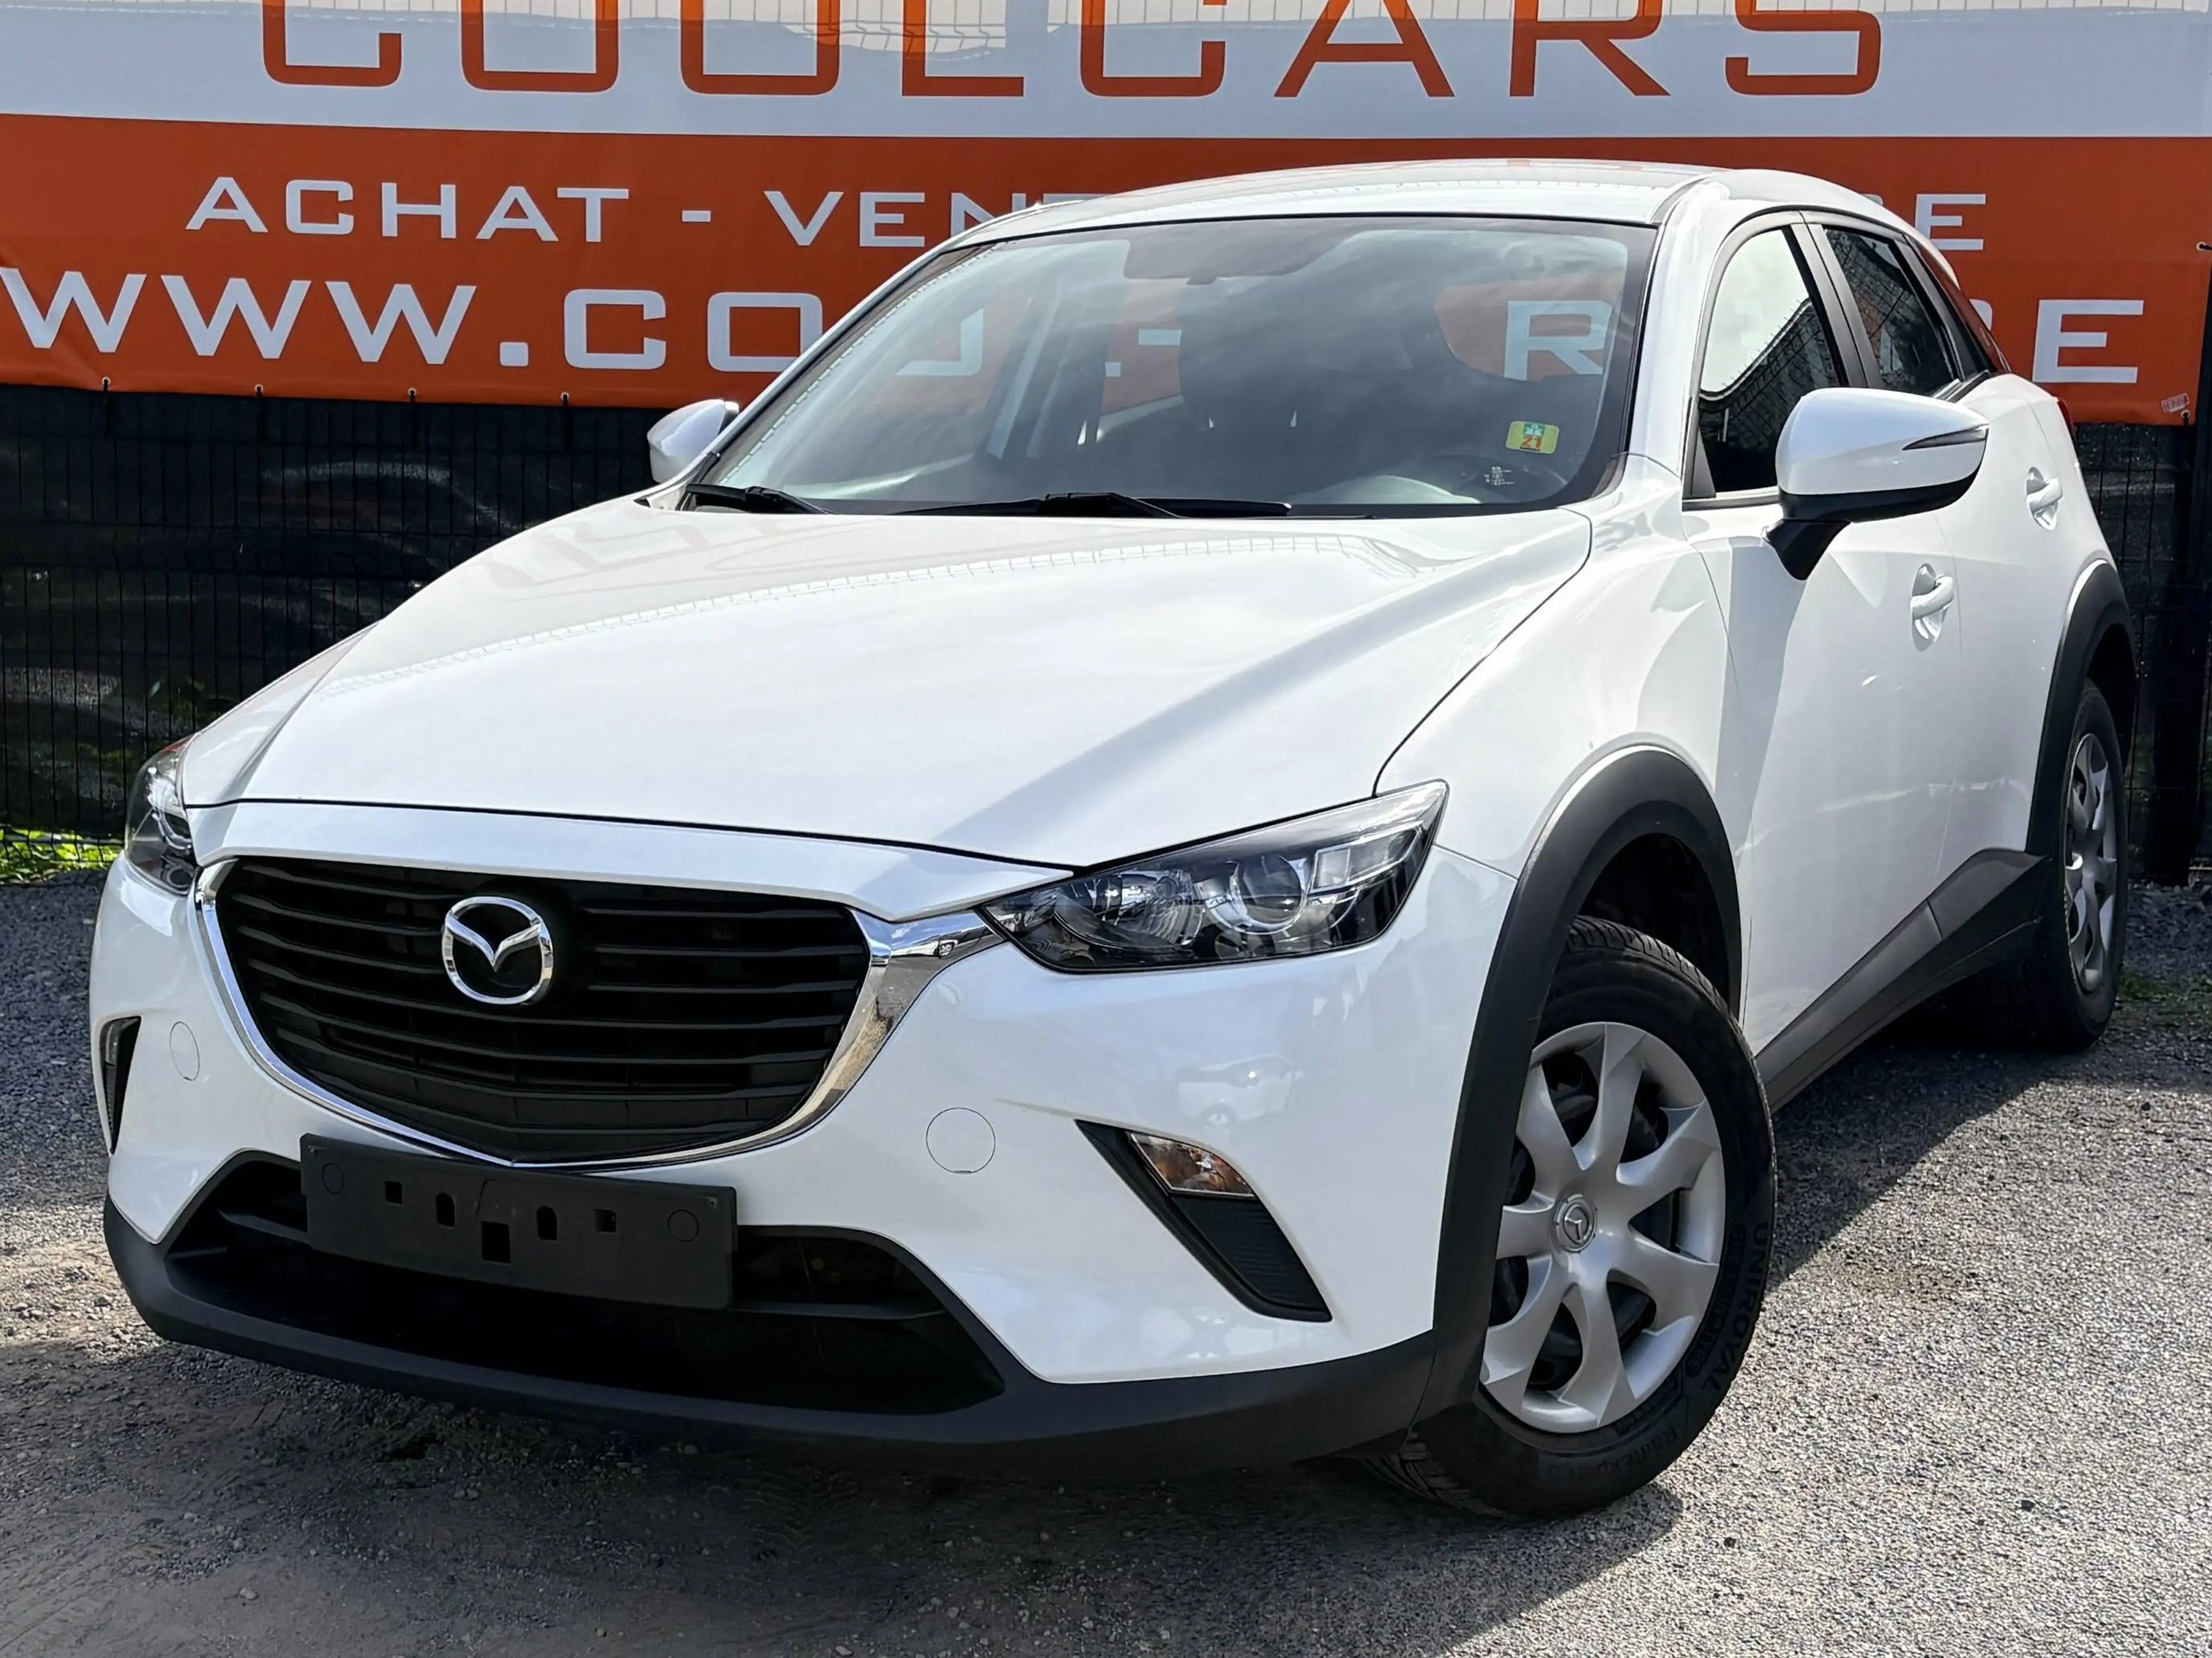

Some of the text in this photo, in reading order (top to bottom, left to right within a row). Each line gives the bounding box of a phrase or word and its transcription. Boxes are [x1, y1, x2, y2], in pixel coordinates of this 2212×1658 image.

[185, 176, 629, 242] ACHAT
[1521, 436, 1542, 449] 21
[1701, 1222, 1768, 1391] UNIROYAL
